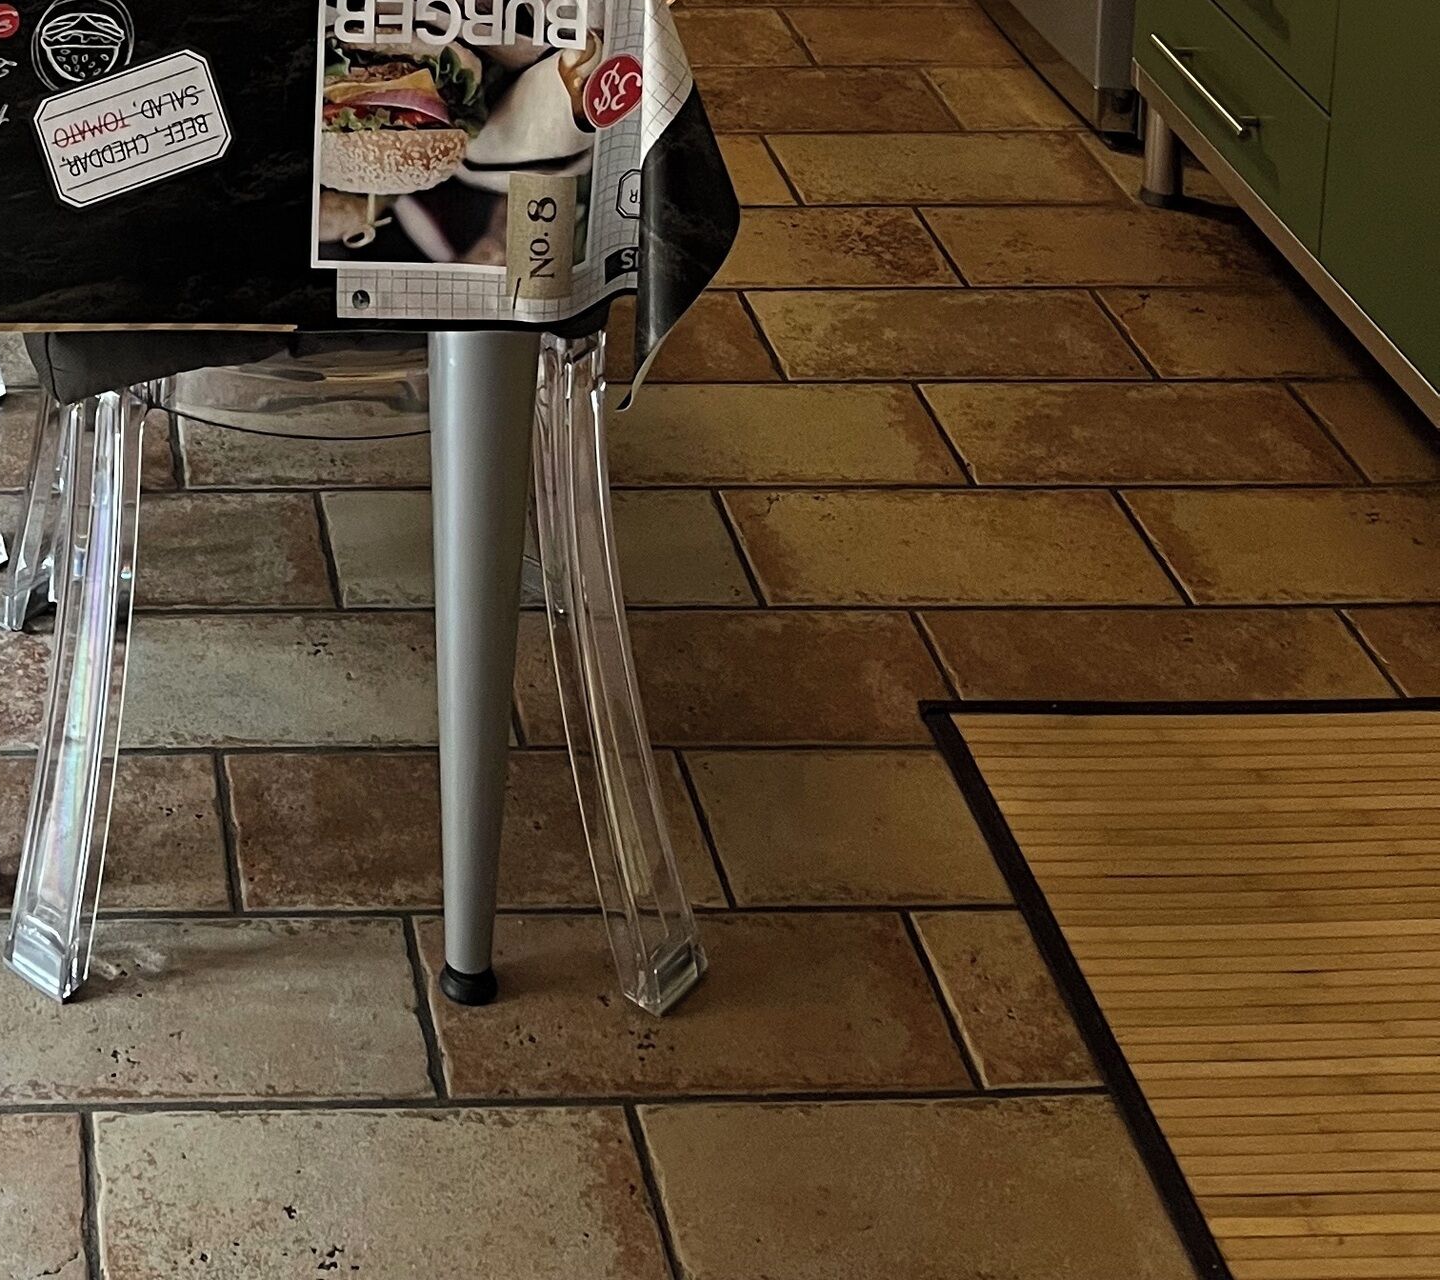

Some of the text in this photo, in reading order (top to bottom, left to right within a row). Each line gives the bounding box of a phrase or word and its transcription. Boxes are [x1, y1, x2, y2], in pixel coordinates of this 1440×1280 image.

[52, 84, 201, 149] SALAD, TOMATO
[593, 62, 643, 116] 3$
[59, 113, 210, 178] BEEF, CHEDDAR,
[526, 196, 558, 281] No. 8
